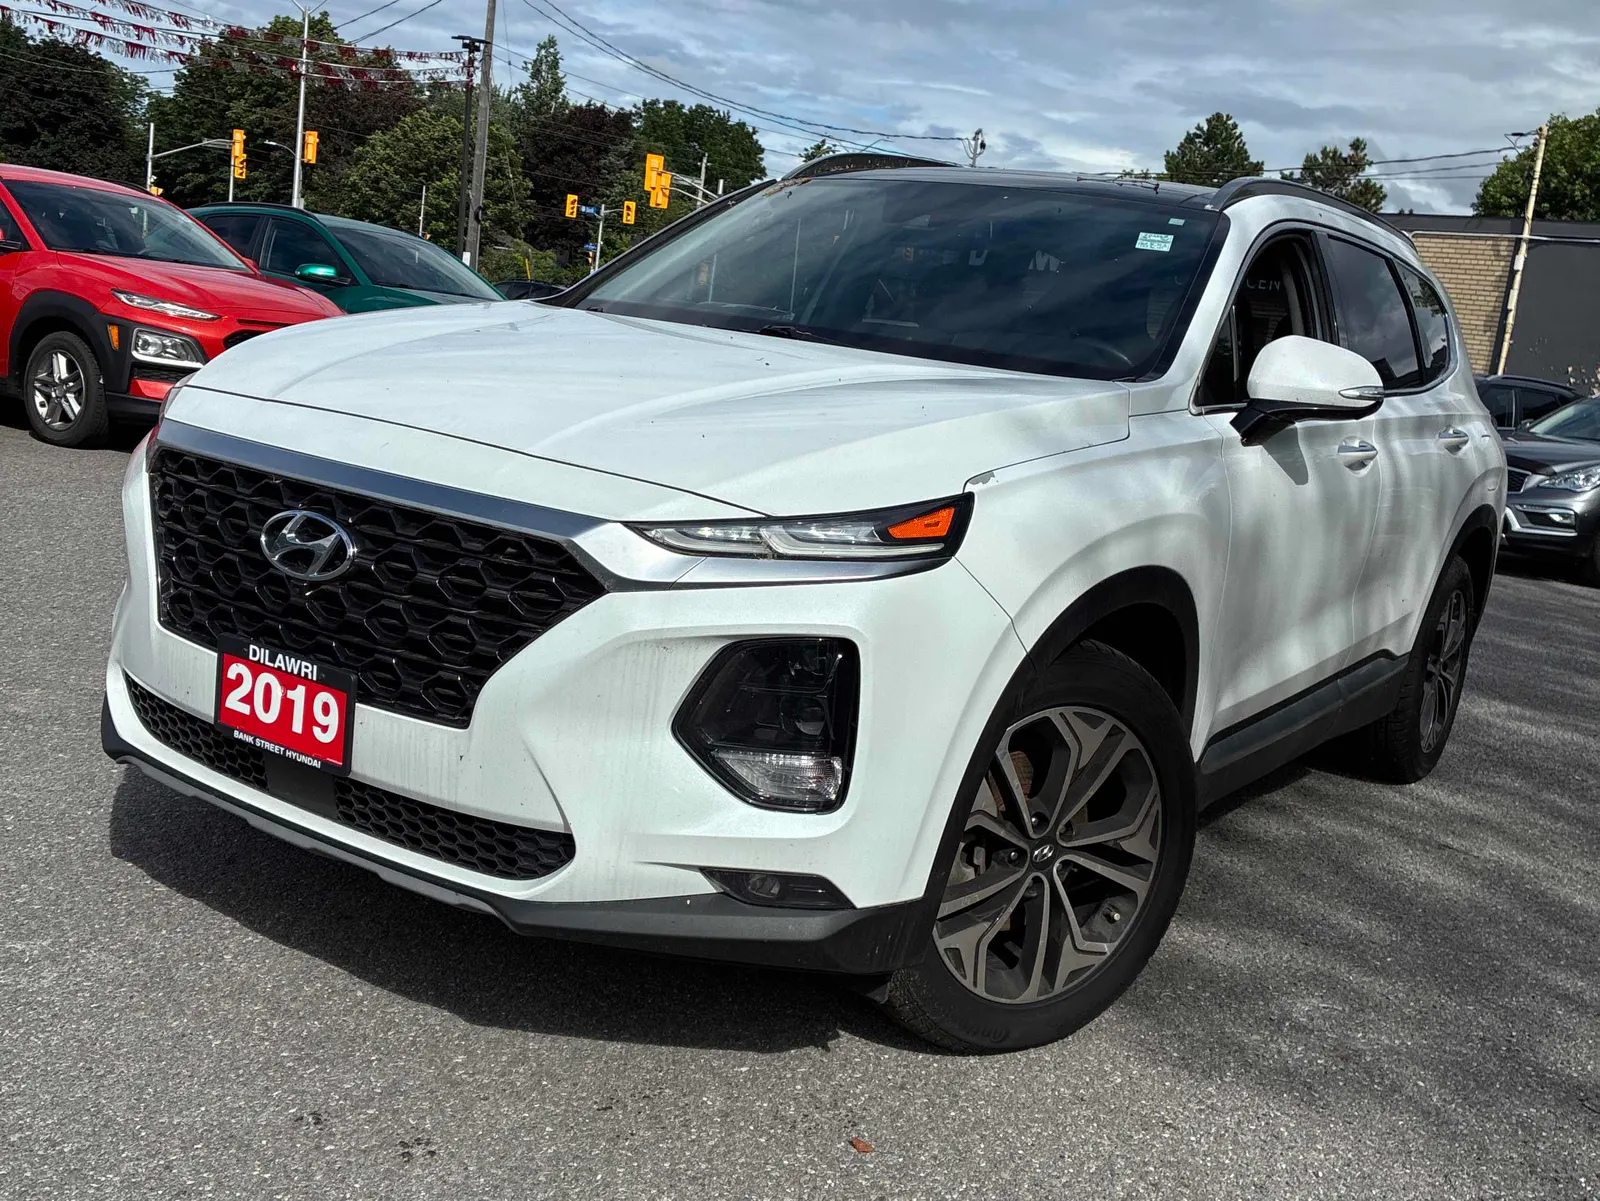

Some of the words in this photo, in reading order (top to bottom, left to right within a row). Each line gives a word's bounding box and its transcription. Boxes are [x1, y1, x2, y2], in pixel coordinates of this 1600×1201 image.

[249, 644, 318, 681] DILAWRI
[224, 663, 339, 743] 2019
[233, 730, 254, 744] BANK
[255, 738, 284, 755] STREET
[285, 749, 321, 768] HYUNDAI
